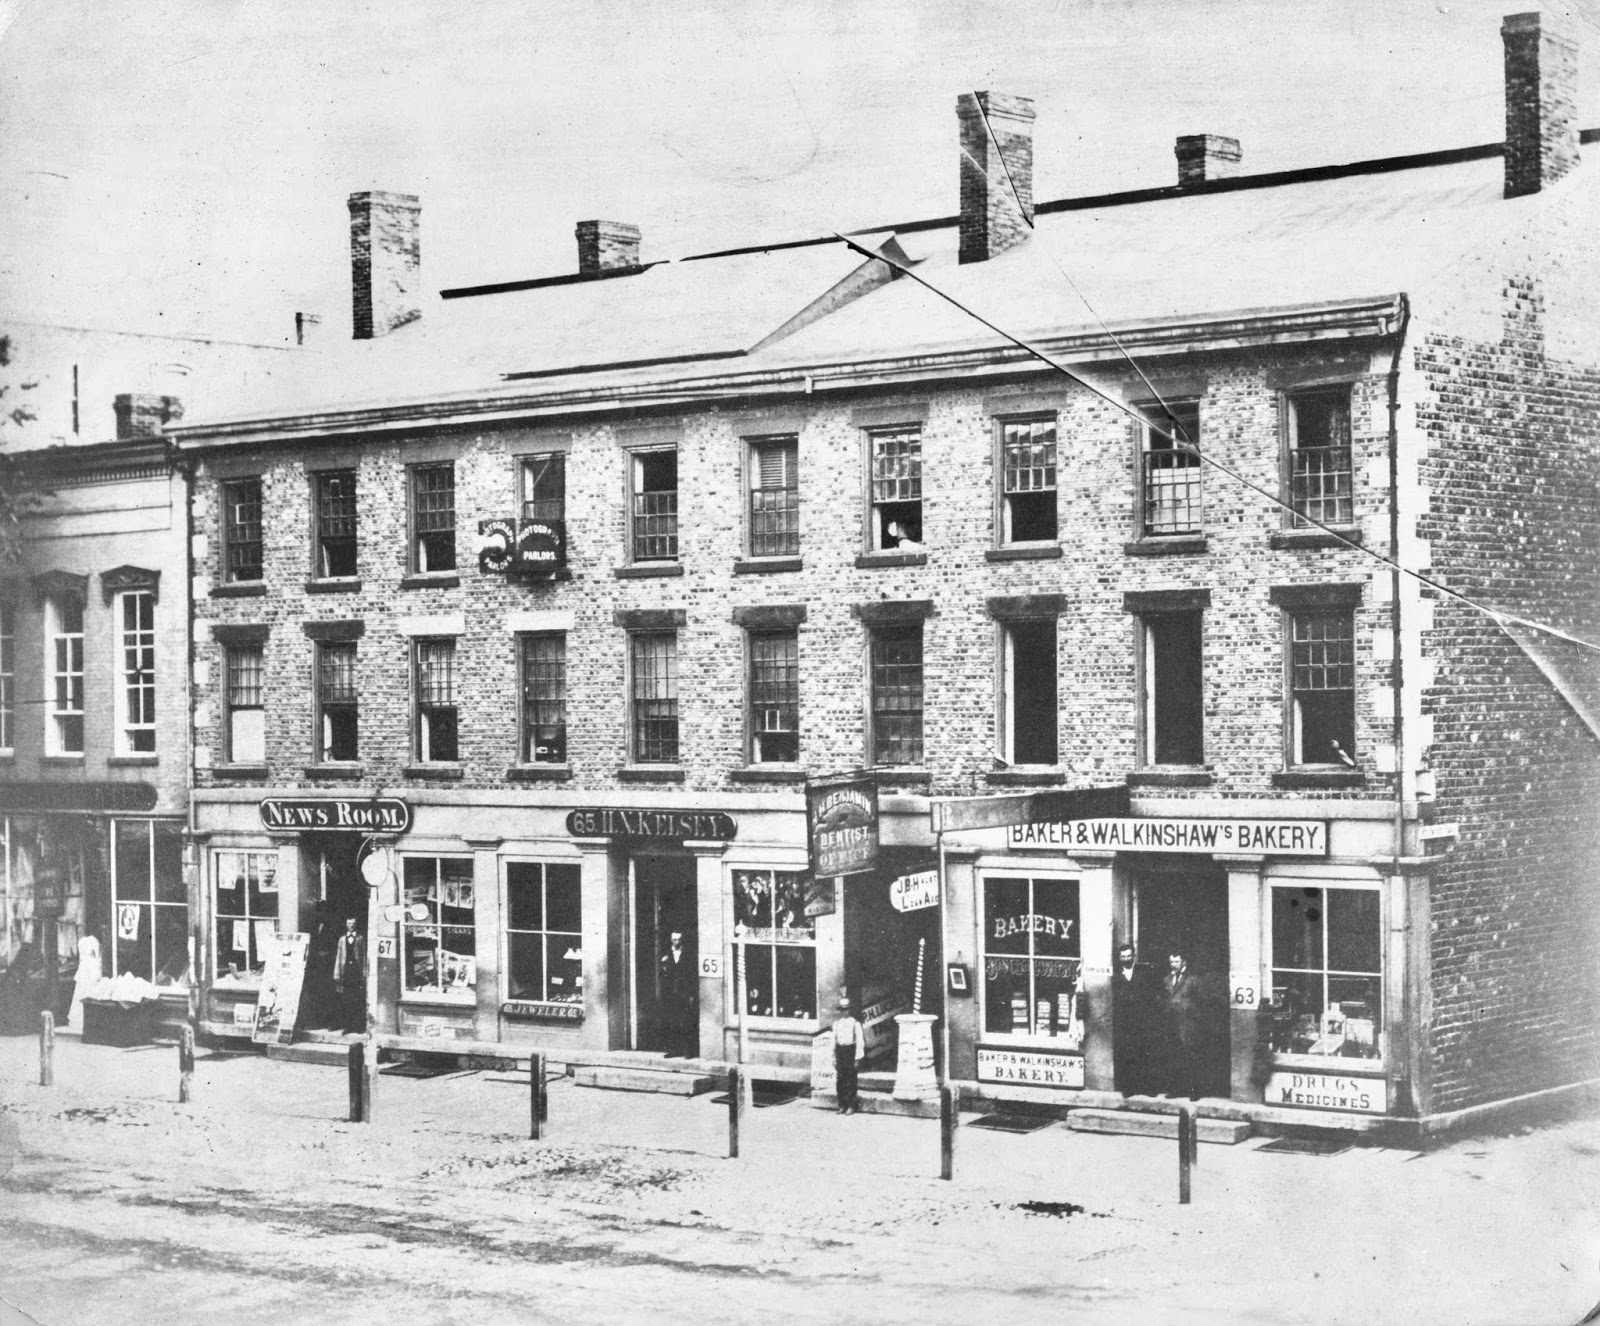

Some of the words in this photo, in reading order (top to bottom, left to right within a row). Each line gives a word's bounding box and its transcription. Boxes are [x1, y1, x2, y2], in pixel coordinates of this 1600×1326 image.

[267, 802, 328, 825] NEWS
[335, 802, 404, 826] ROOM.
[1012, 823, 1072, 844] BAKER
[1076, 822, 1090, 844] &
[1238, 825, 1323, 850] BAKERY.
[994, 914, 1073, 939] BAKERY
[378, 940, 392, 955] 67
[702, 958, 718, 973] 65
[1235, 986, 1254, 1004] 63
[513, 1005, 567, 1017] JEWELER
[979, 1052, 1008, 1062] BAKER
[1281, 1087, 1370, 1109] MEDICINES
